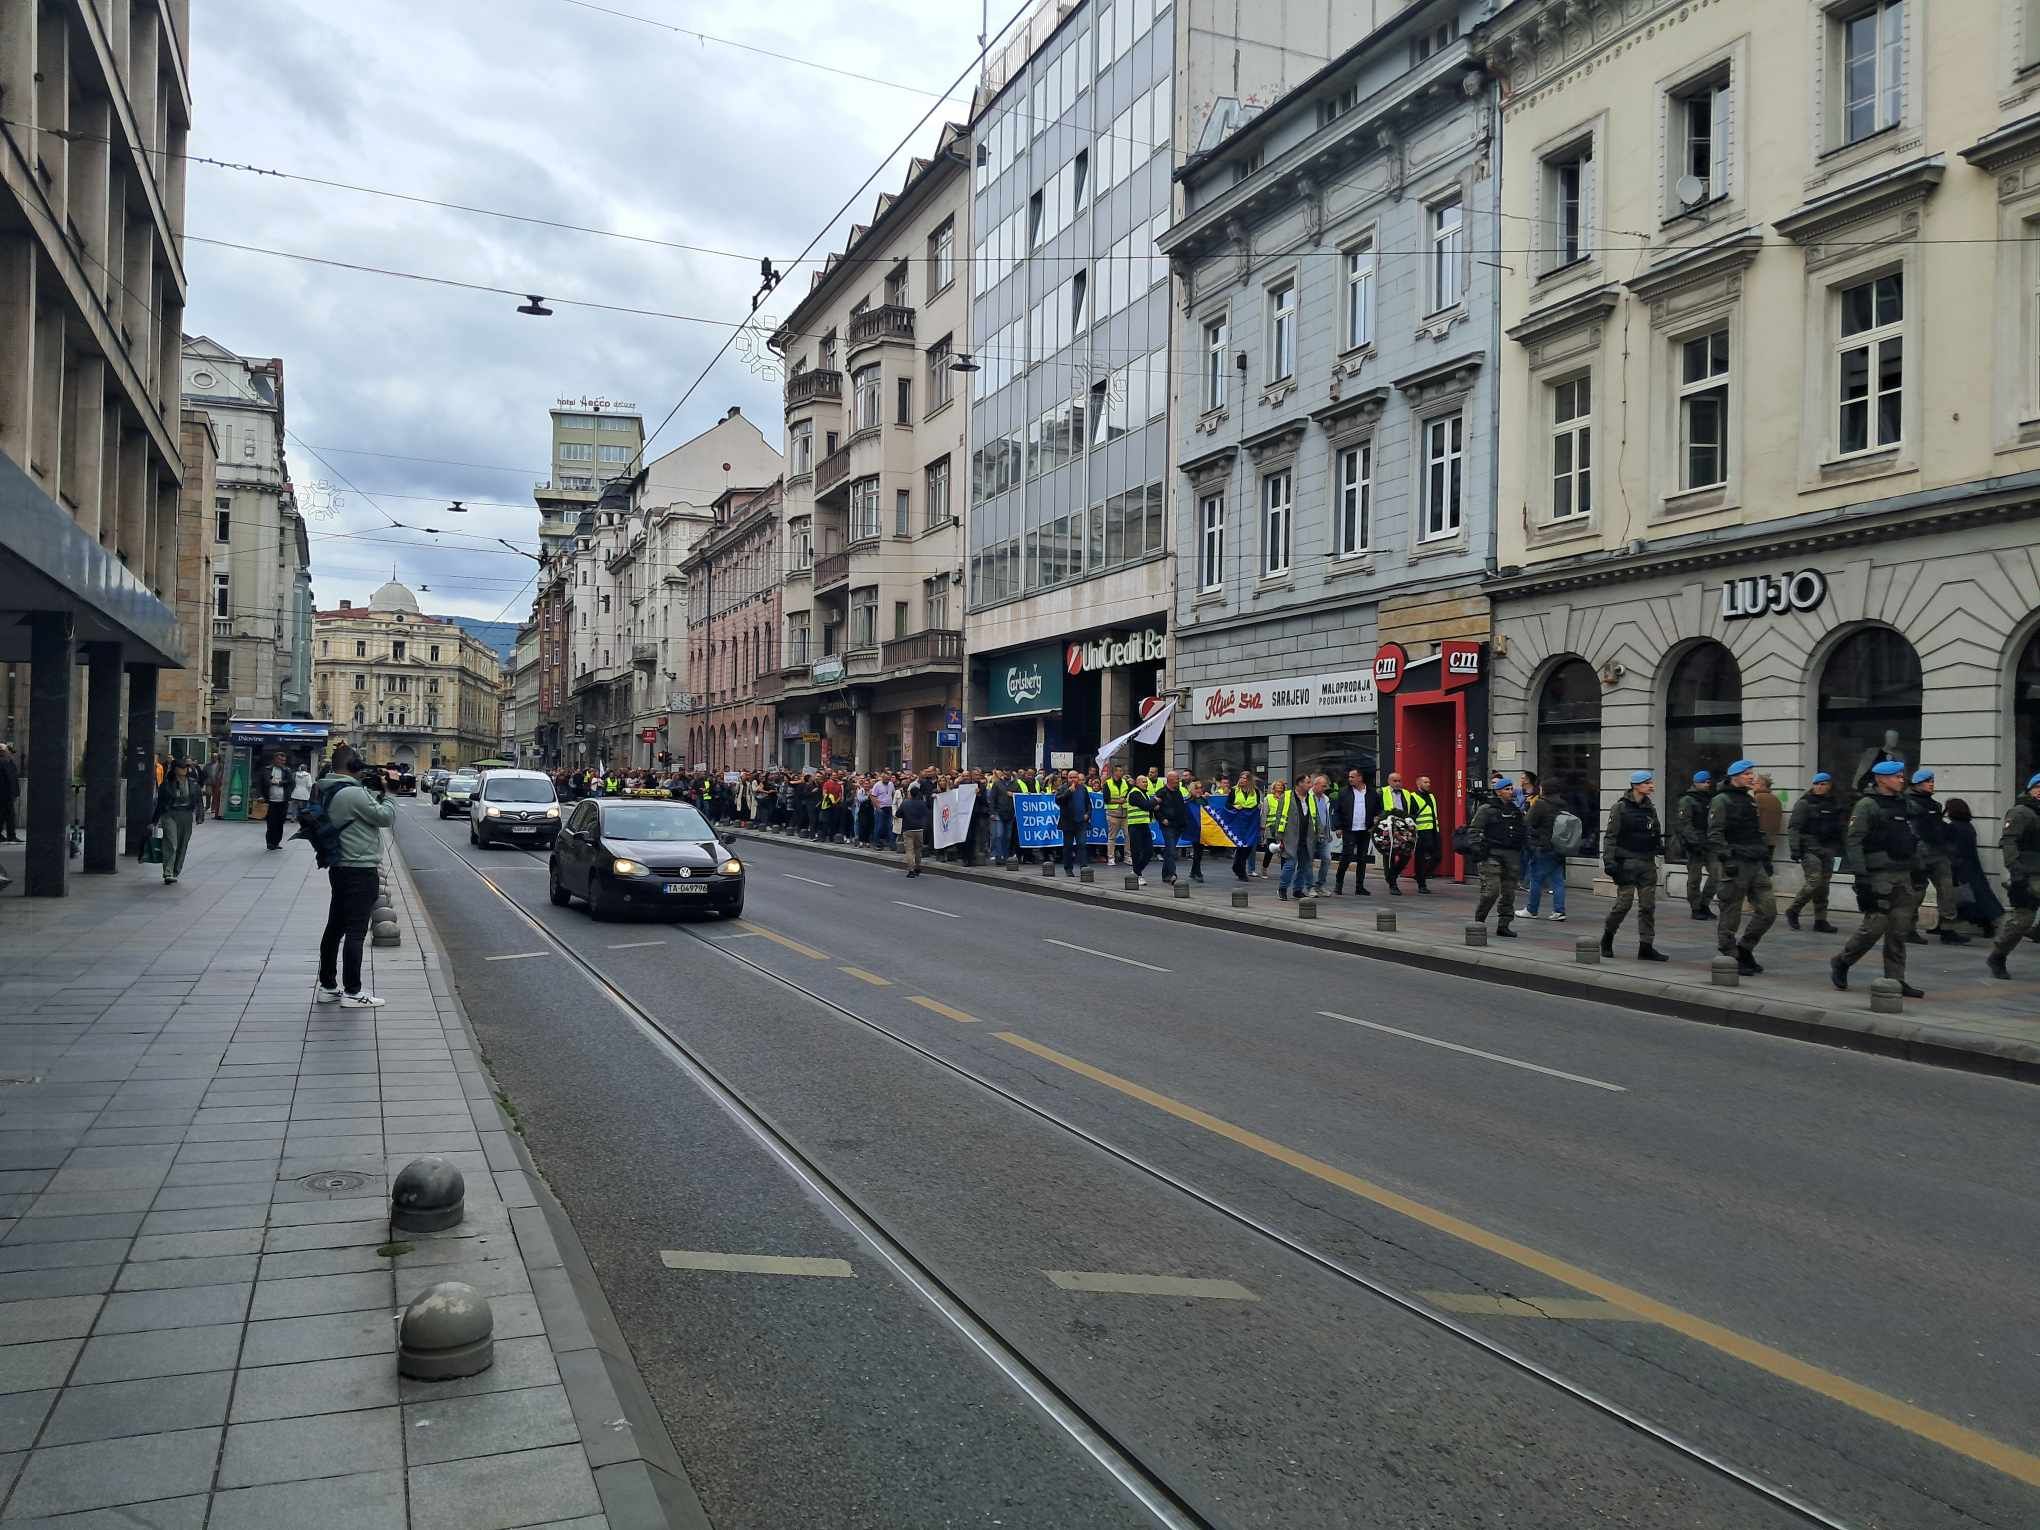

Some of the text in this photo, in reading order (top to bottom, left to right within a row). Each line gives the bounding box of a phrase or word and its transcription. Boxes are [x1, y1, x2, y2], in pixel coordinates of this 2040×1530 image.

[1082, 631, 1144, 671] UniCredit
[1449, 651, 1479, 668] cm
[1375, 657, 1397, 674] cm
[1006, 664, 1042, 704] Carlsberg
[1321, 679, 1371, 695] MALOPRODAJA
[1271, 688, 1310, 707] SARAJEVO
[1318, 693, 1358, 706] PRODAVNICA
[1024, 830, 1031, 841] U
